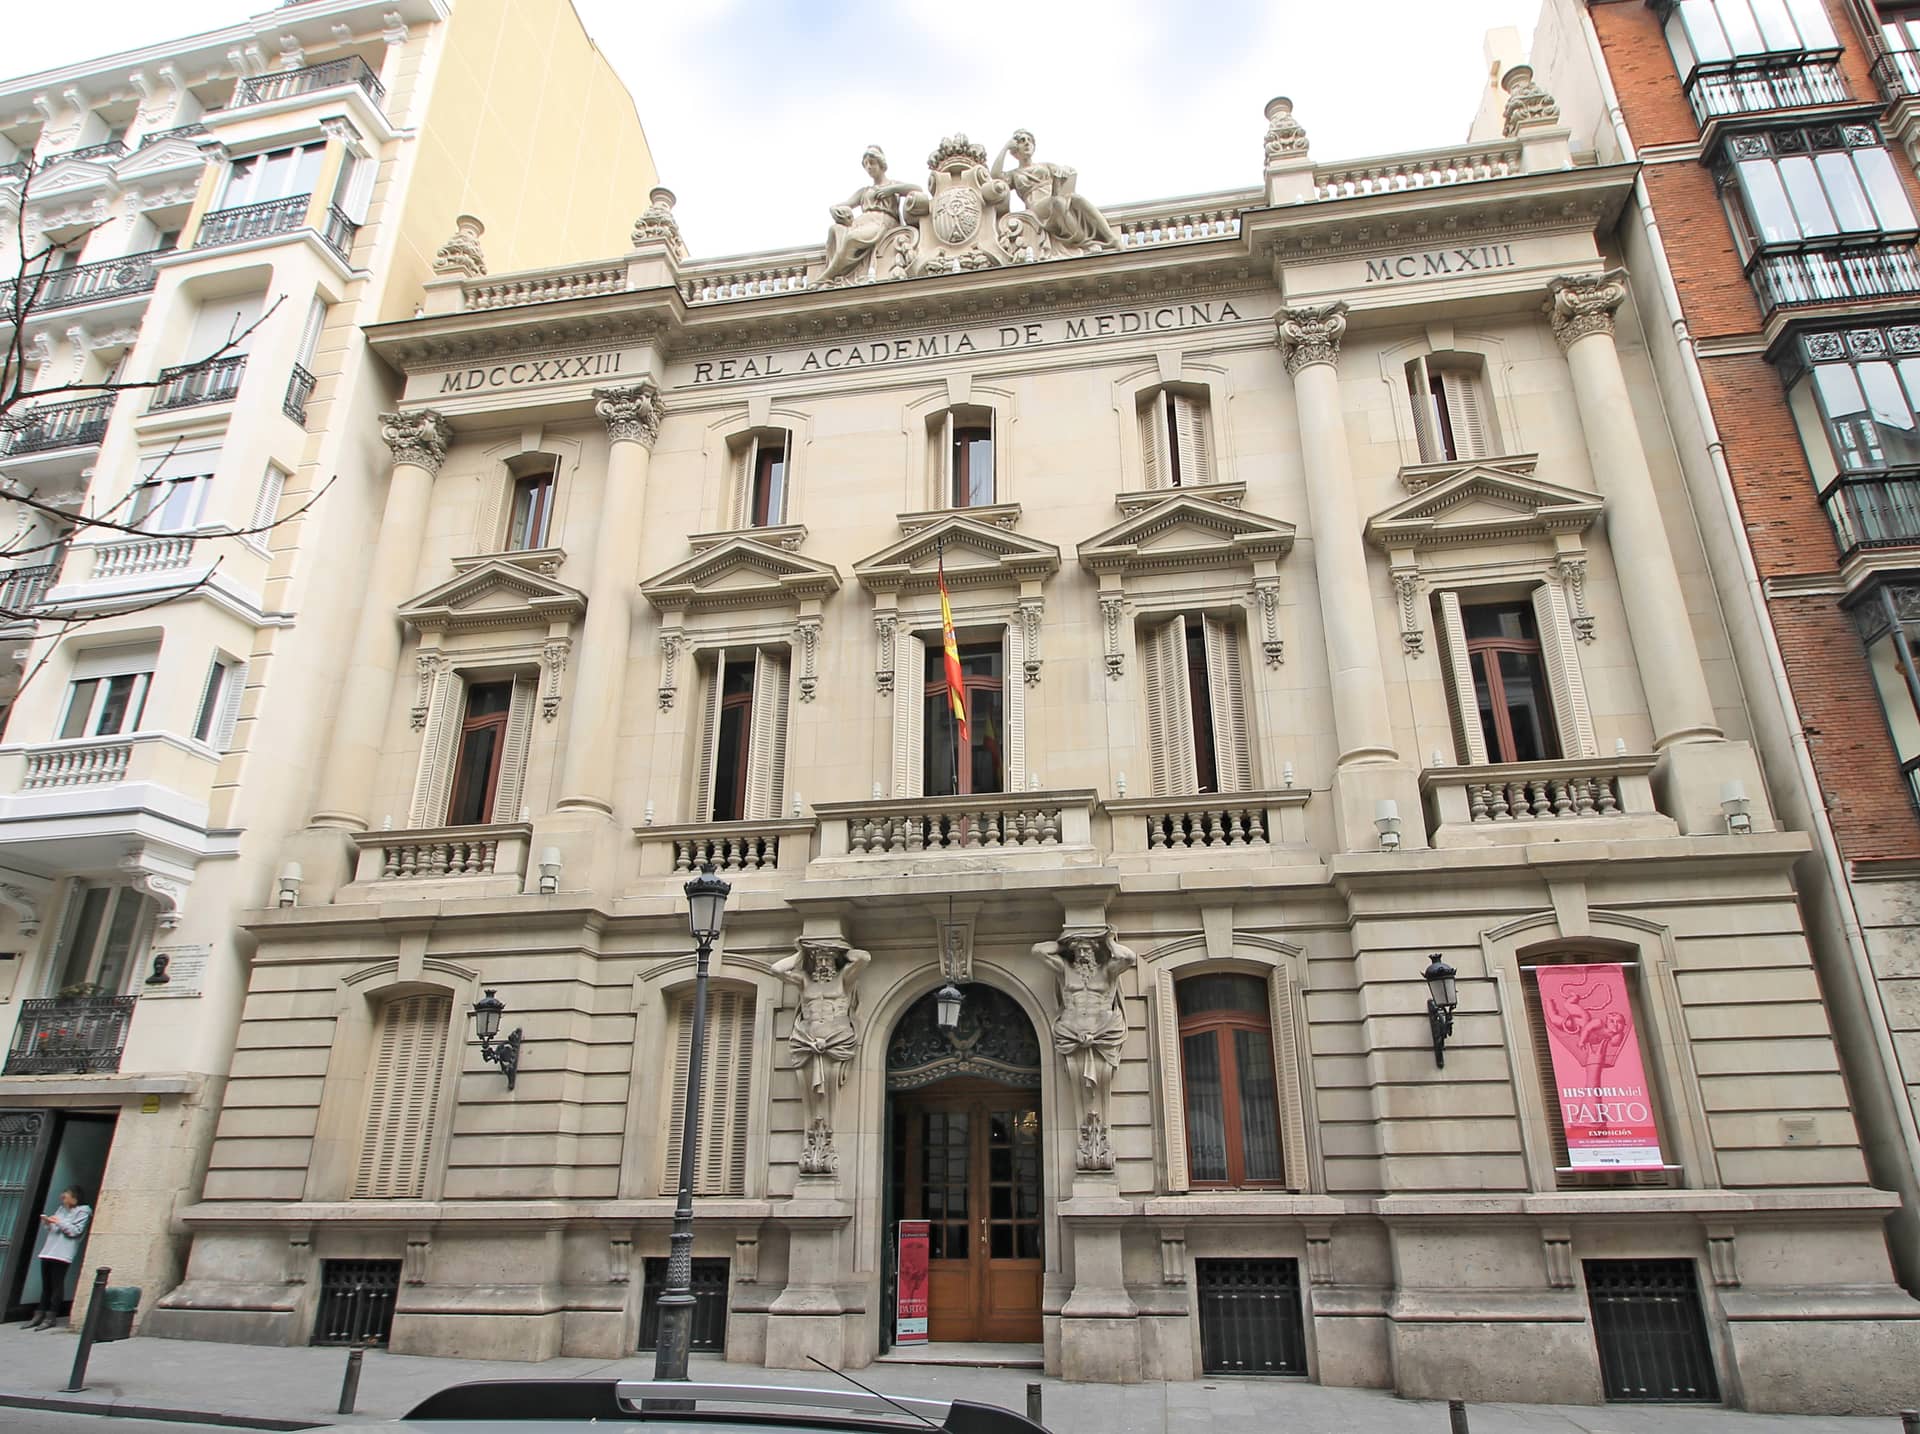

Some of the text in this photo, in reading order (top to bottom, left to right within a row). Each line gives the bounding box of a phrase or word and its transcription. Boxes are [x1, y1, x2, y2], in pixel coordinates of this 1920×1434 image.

[1365, 244, 1515, 282] MCMXIII
[693, 302, 1242, 383] REAL ACADEMIA DE MEDICINA
[440, 353, 621, 393] MDCCXXXIII
[1565, 1102, 1648, 1123] PARTO
